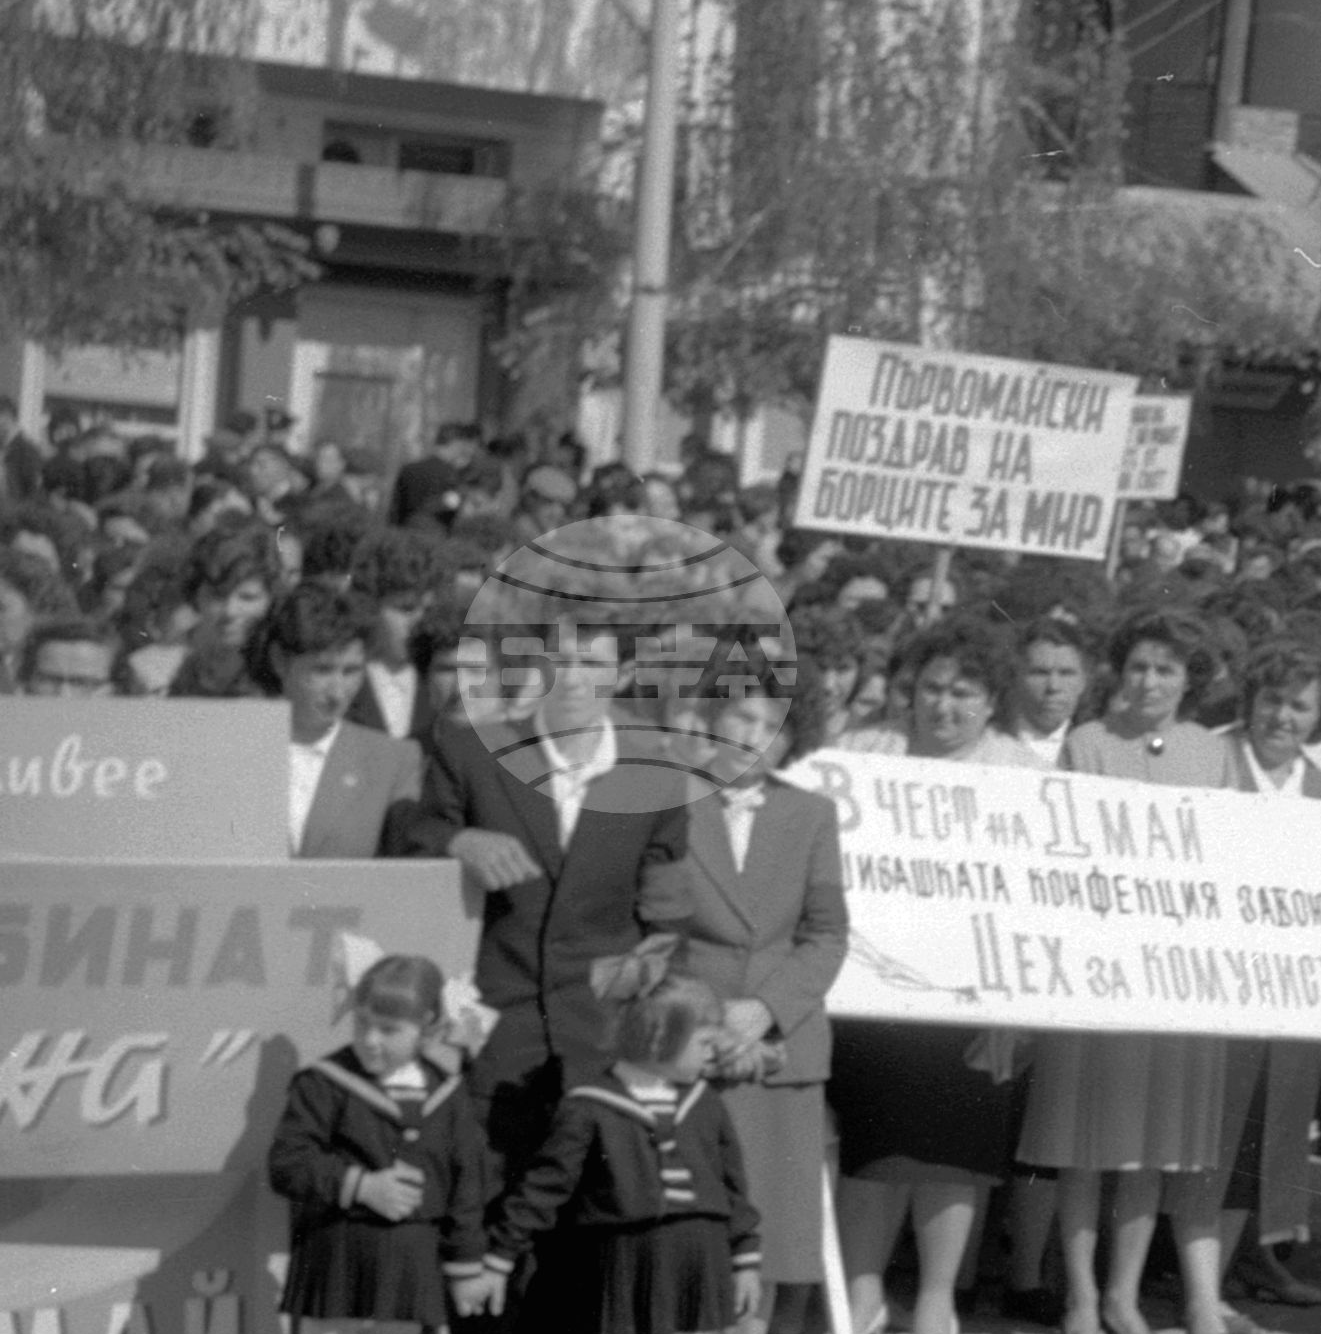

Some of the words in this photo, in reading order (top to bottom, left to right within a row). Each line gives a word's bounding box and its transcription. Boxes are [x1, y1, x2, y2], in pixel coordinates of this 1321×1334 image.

[869, 351, 1110, 434] ПЪРВОМАЙСКИ
[825, 409, 970, 476] ПОЗДРАВ
[988, 433, 1033, 484] НА
[813, 468, 958, 535] БОРЦИТЕ
[965, 486, 1010, 540] ЗА
[1021, 490, 1104, 551] МИР
[0, 734, 167, 800] ивее
[810, 760, 862, 834] В
[873, 777, 979, 843] ЧЕСТ
[985, 811, 1033, 849] НА
[1097, 796, 1204, 863] МАЙ
[1028, 865, 1222, 926] КОНФЕКЦИЯ
[1085, 955, 1132, 1000] ЗА
